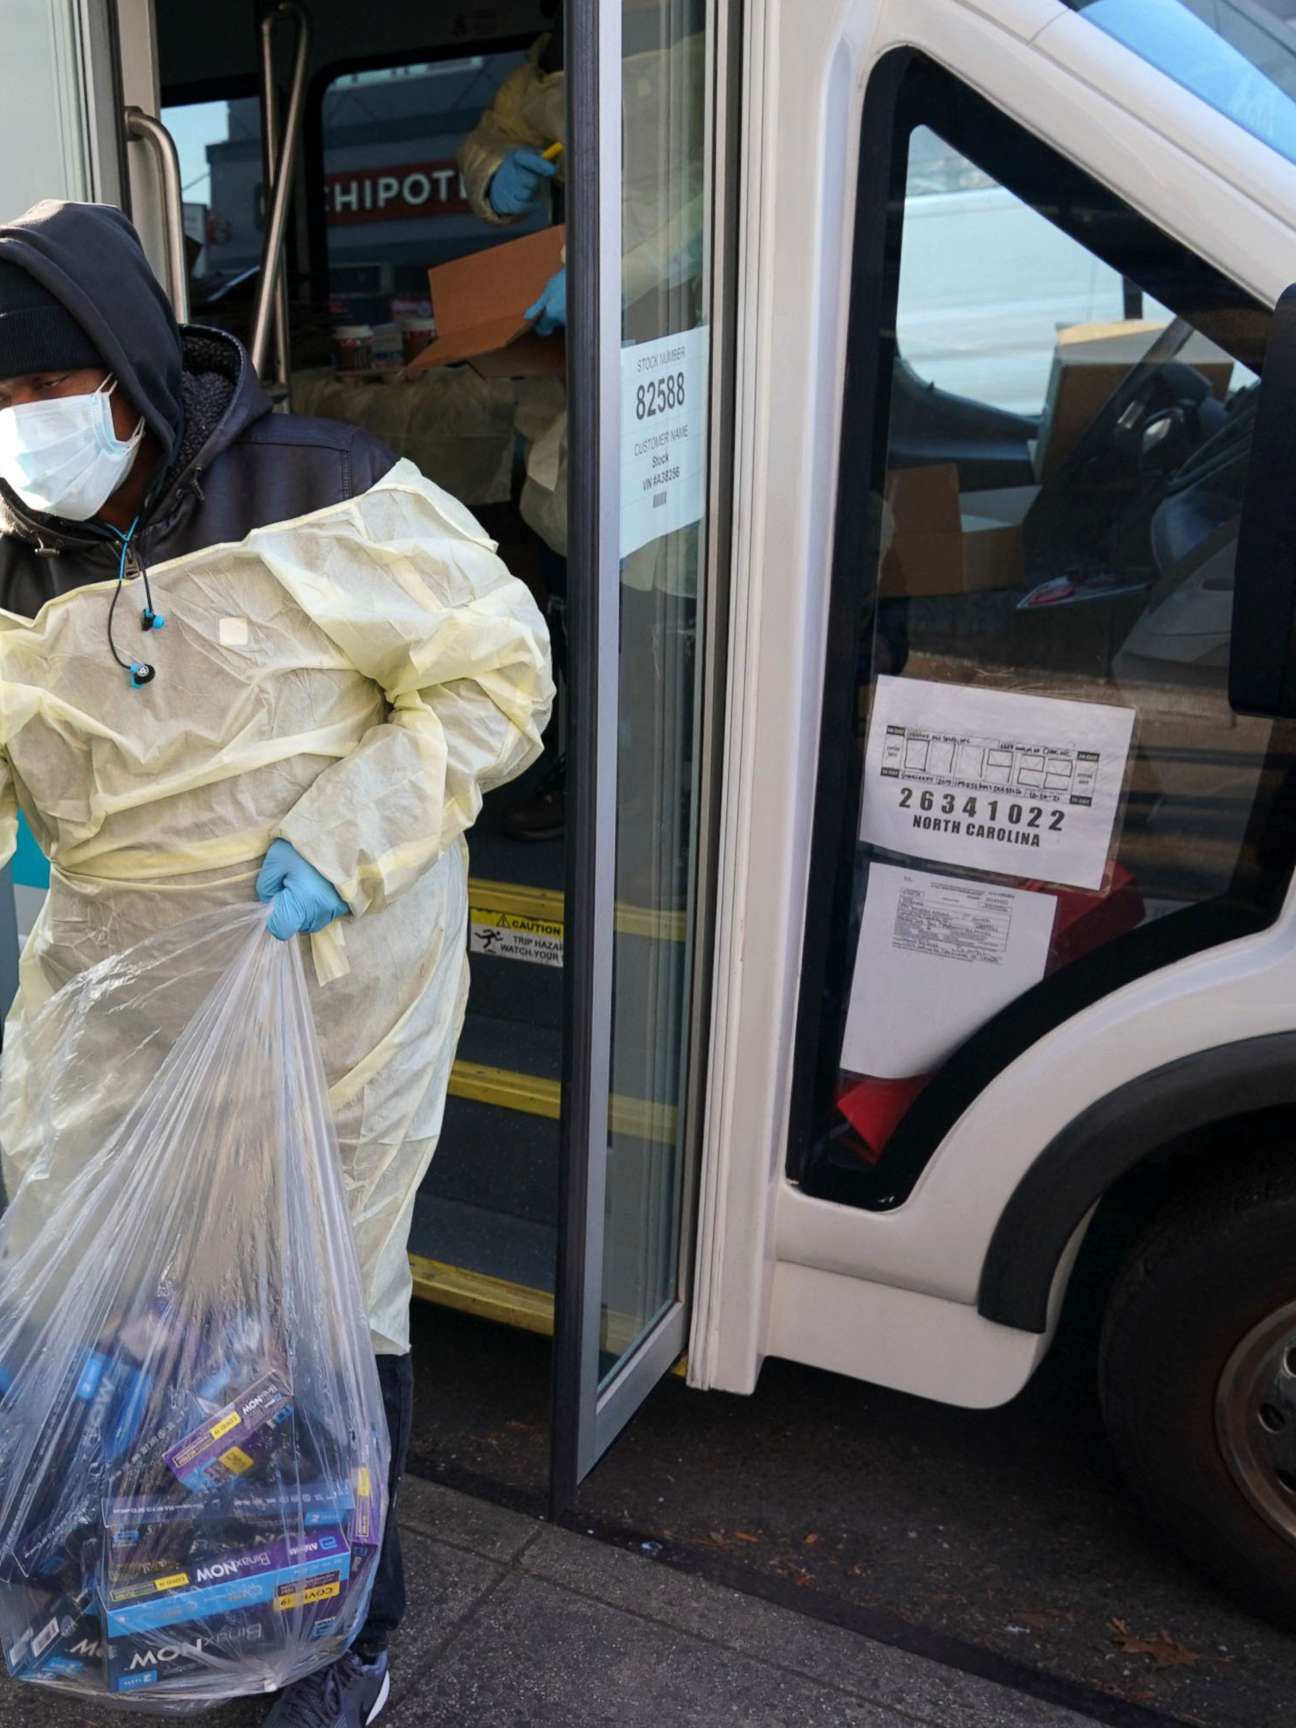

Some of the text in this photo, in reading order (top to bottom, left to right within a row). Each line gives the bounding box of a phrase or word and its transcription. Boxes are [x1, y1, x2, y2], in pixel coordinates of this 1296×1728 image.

[324, 169, 467, 213] HIPOT
[636, 346, 686, 374] STOCK NUMBER
[636, 371, 685, 420] 82588
[634, 424, 689, 456] CUSTOMER NAME
[652, 451, 669, 469] Stock
[898, 787, 1066, 832] 26341022
[912, 814, 1041, 848] NORTH CAROLINA
[511, 919, 561, 936] CAUTION
[513, 935, 532, 947] TRIP
[500, 943, 560, 961] WATCH YOUR
[196, 1551, 272, 1583] BinaxNOW
[128, 1622, 263, 1670] BinaxNOW
